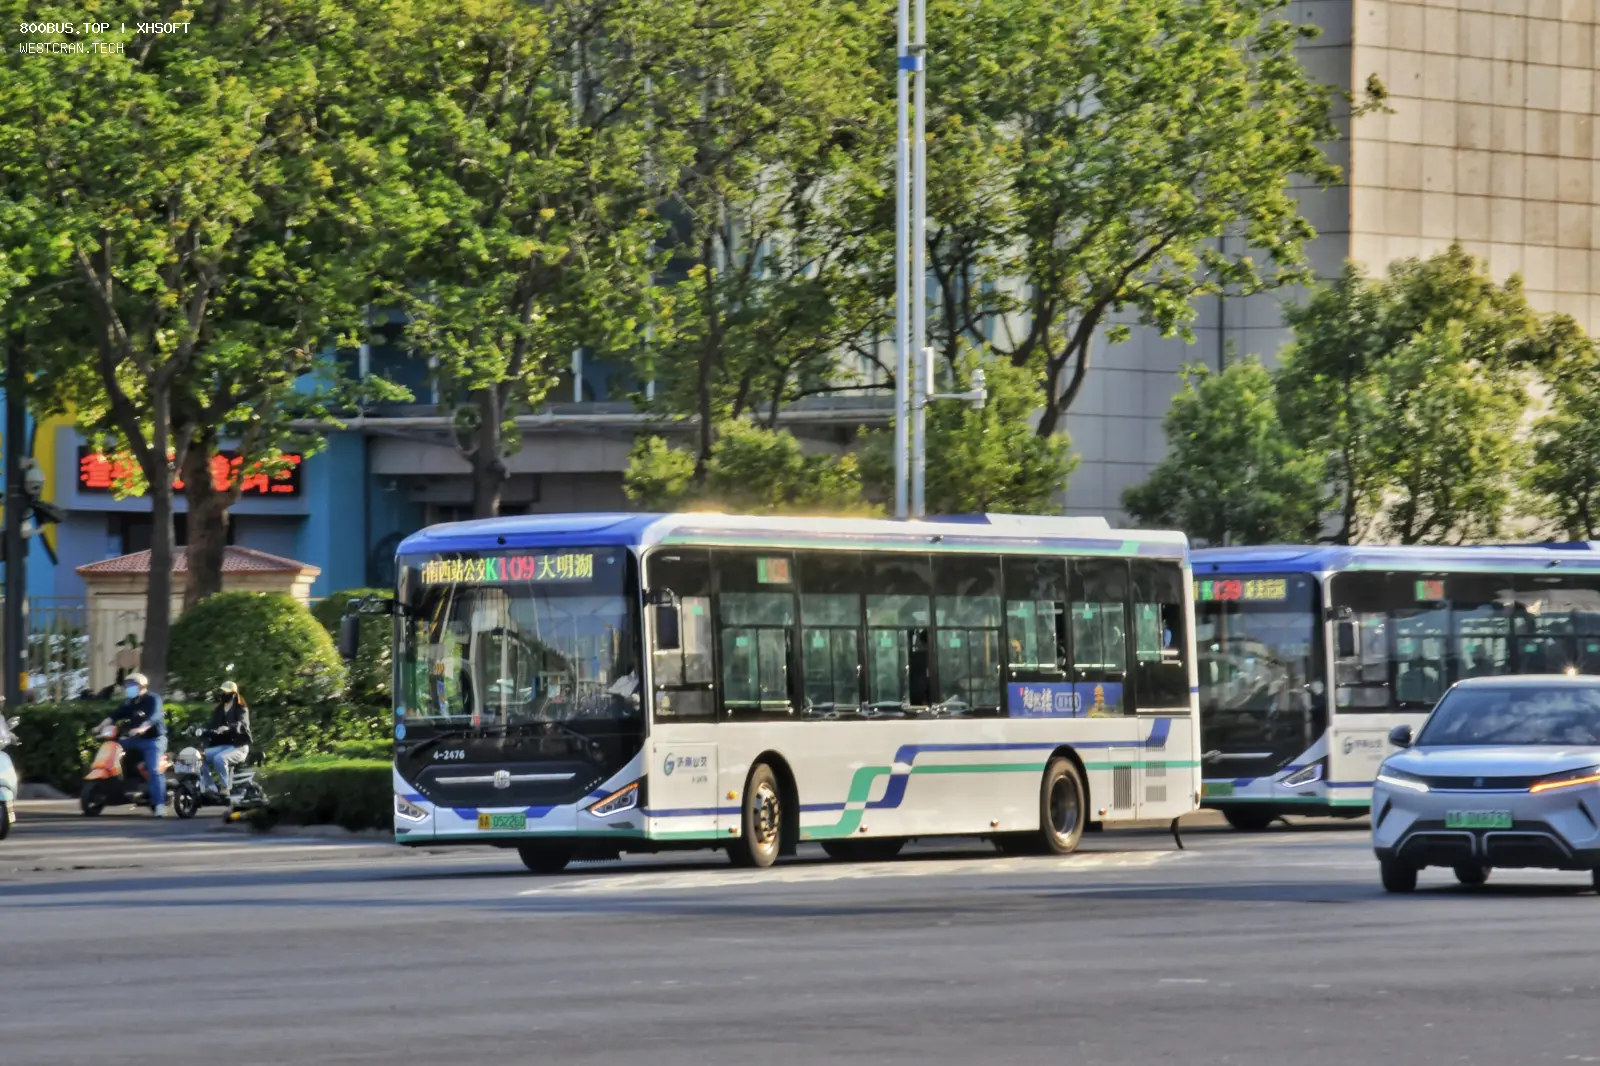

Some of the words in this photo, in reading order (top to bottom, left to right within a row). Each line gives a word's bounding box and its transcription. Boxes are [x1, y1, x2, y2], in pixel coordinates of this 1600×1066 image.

[537, 553, 594, 580] 大明湖
[432, 749, 466, 760] 4-2476
